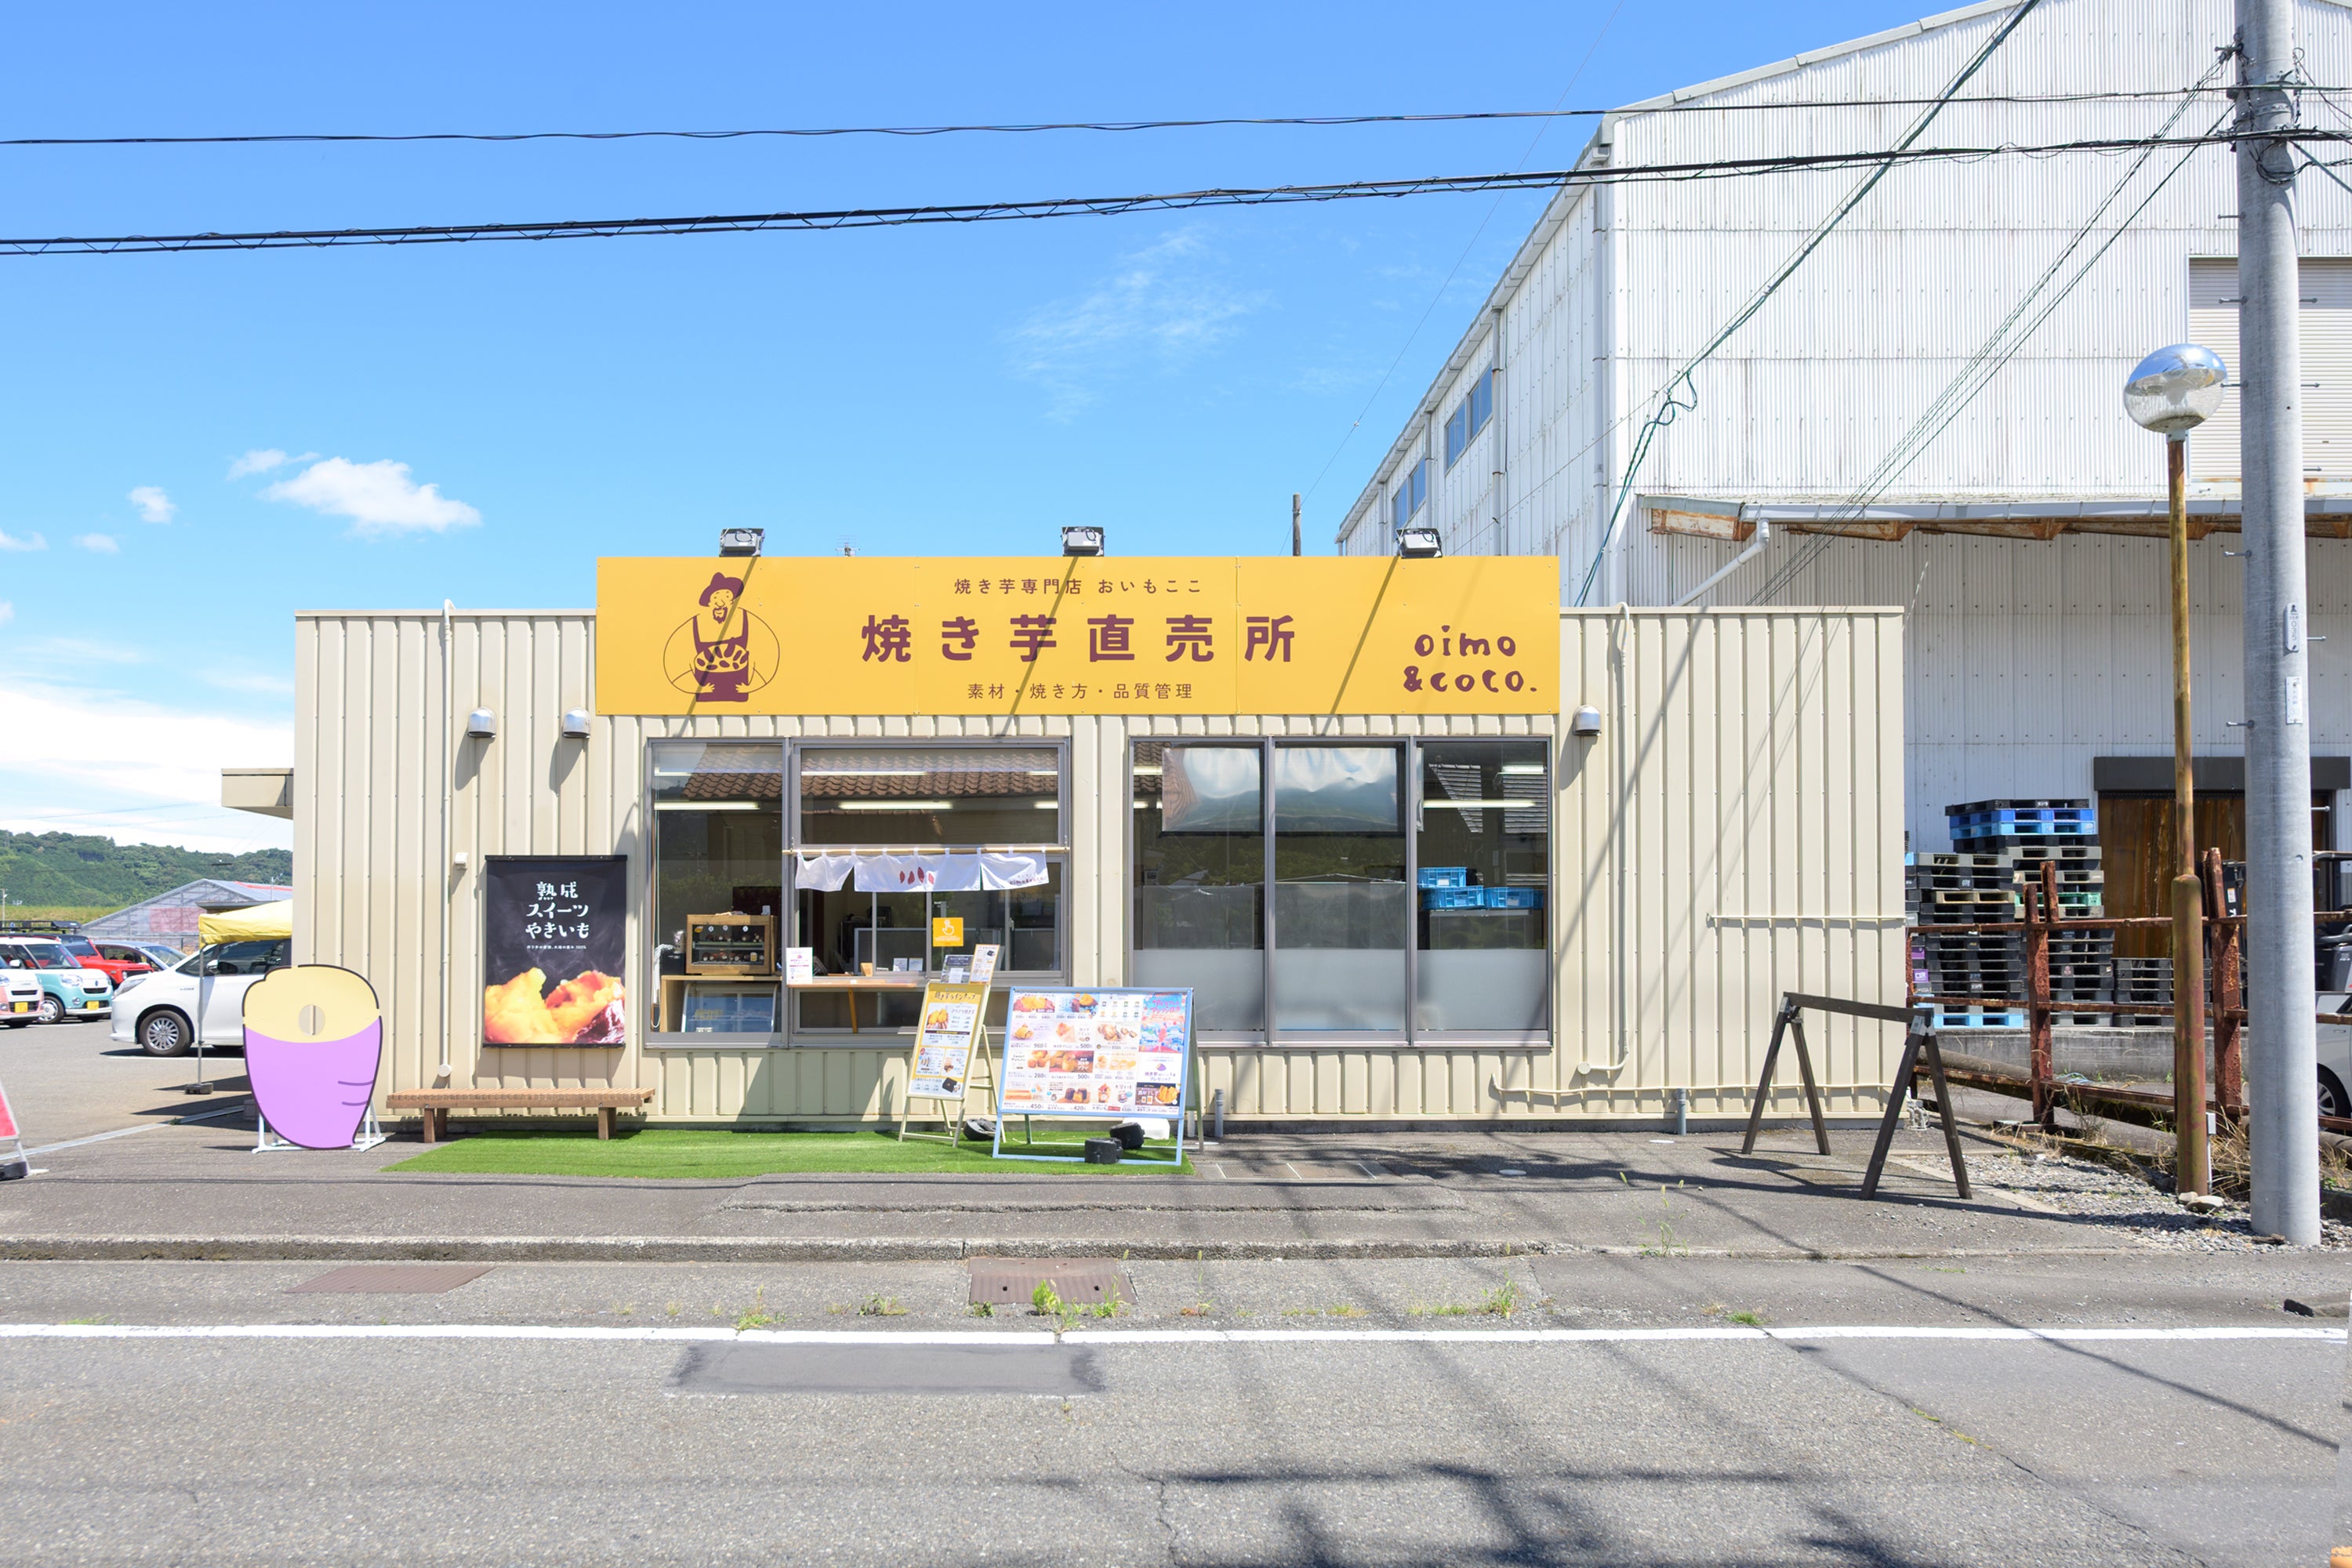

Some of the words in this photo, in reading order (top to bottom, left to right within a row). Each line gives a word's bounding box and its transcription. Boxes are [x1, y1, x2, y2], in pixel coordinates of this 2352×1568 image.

[954, 579, 1082, 595] 焼き芋専門店
[1098, 579, 1202, 594] おいもここ
[862, 614, 1295, 662] 焼き芋直売所
[1414, 625, 1516, 657] oimo
[1403, 666, 1537, 692] &coco.
[967, 683, 1192, 699] 素材・焼き方・品質管理
[536, 881, 579, 901] 熟成
[526, 902, 589, 919] スイーツ
[525, 921, 589, 939] やきいも
